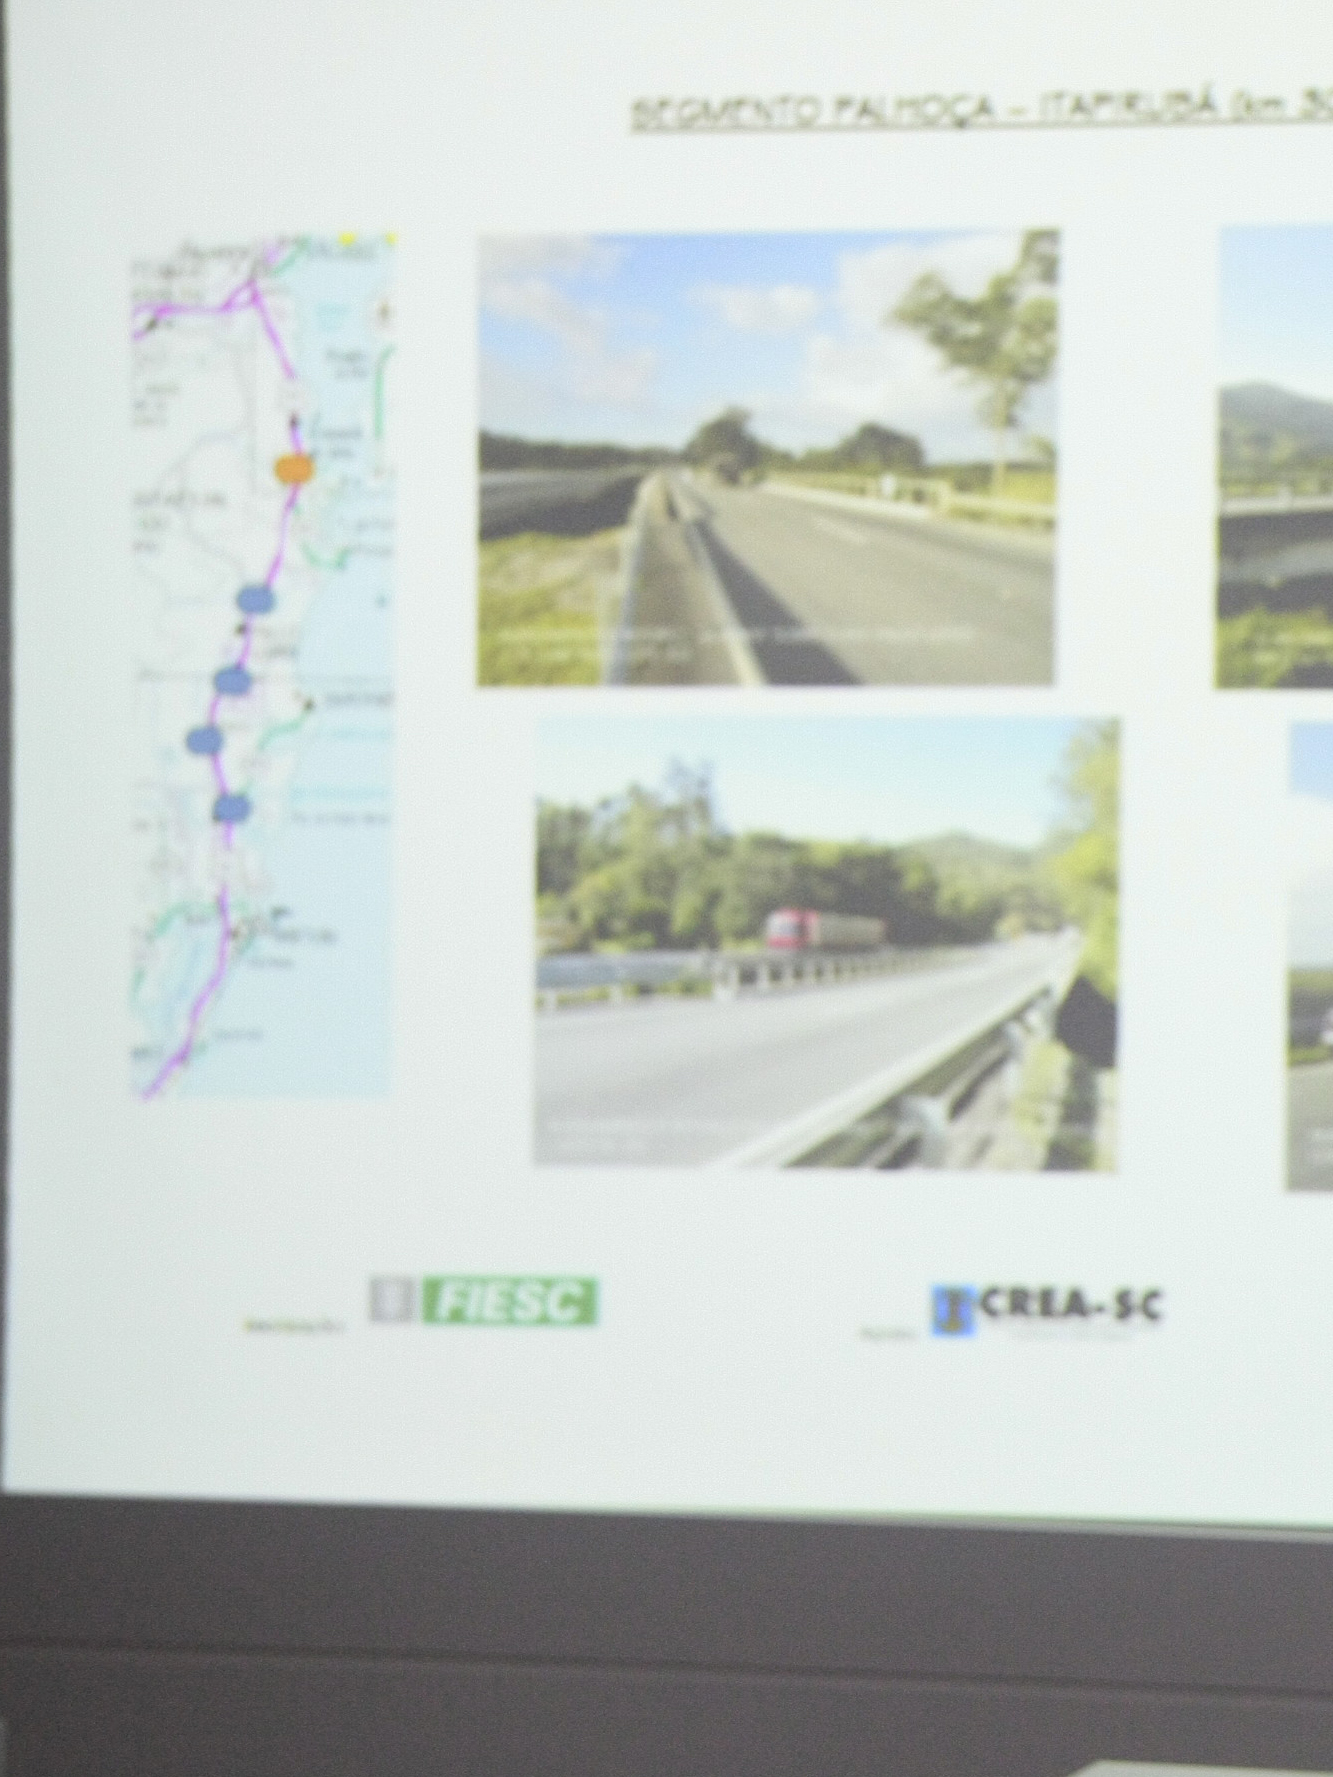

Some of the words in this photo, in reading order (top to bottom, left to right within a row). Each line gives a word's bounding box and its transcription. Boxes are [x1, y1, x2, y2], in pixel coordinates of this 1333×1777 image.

[631, 94, 822, 129] SEGMENTO
[834, 92, 994, 130] PALHOÇA
[433, 1277, 586, 1321] FIESC
[980, 1283, 1166, 1322] CREA-SC
